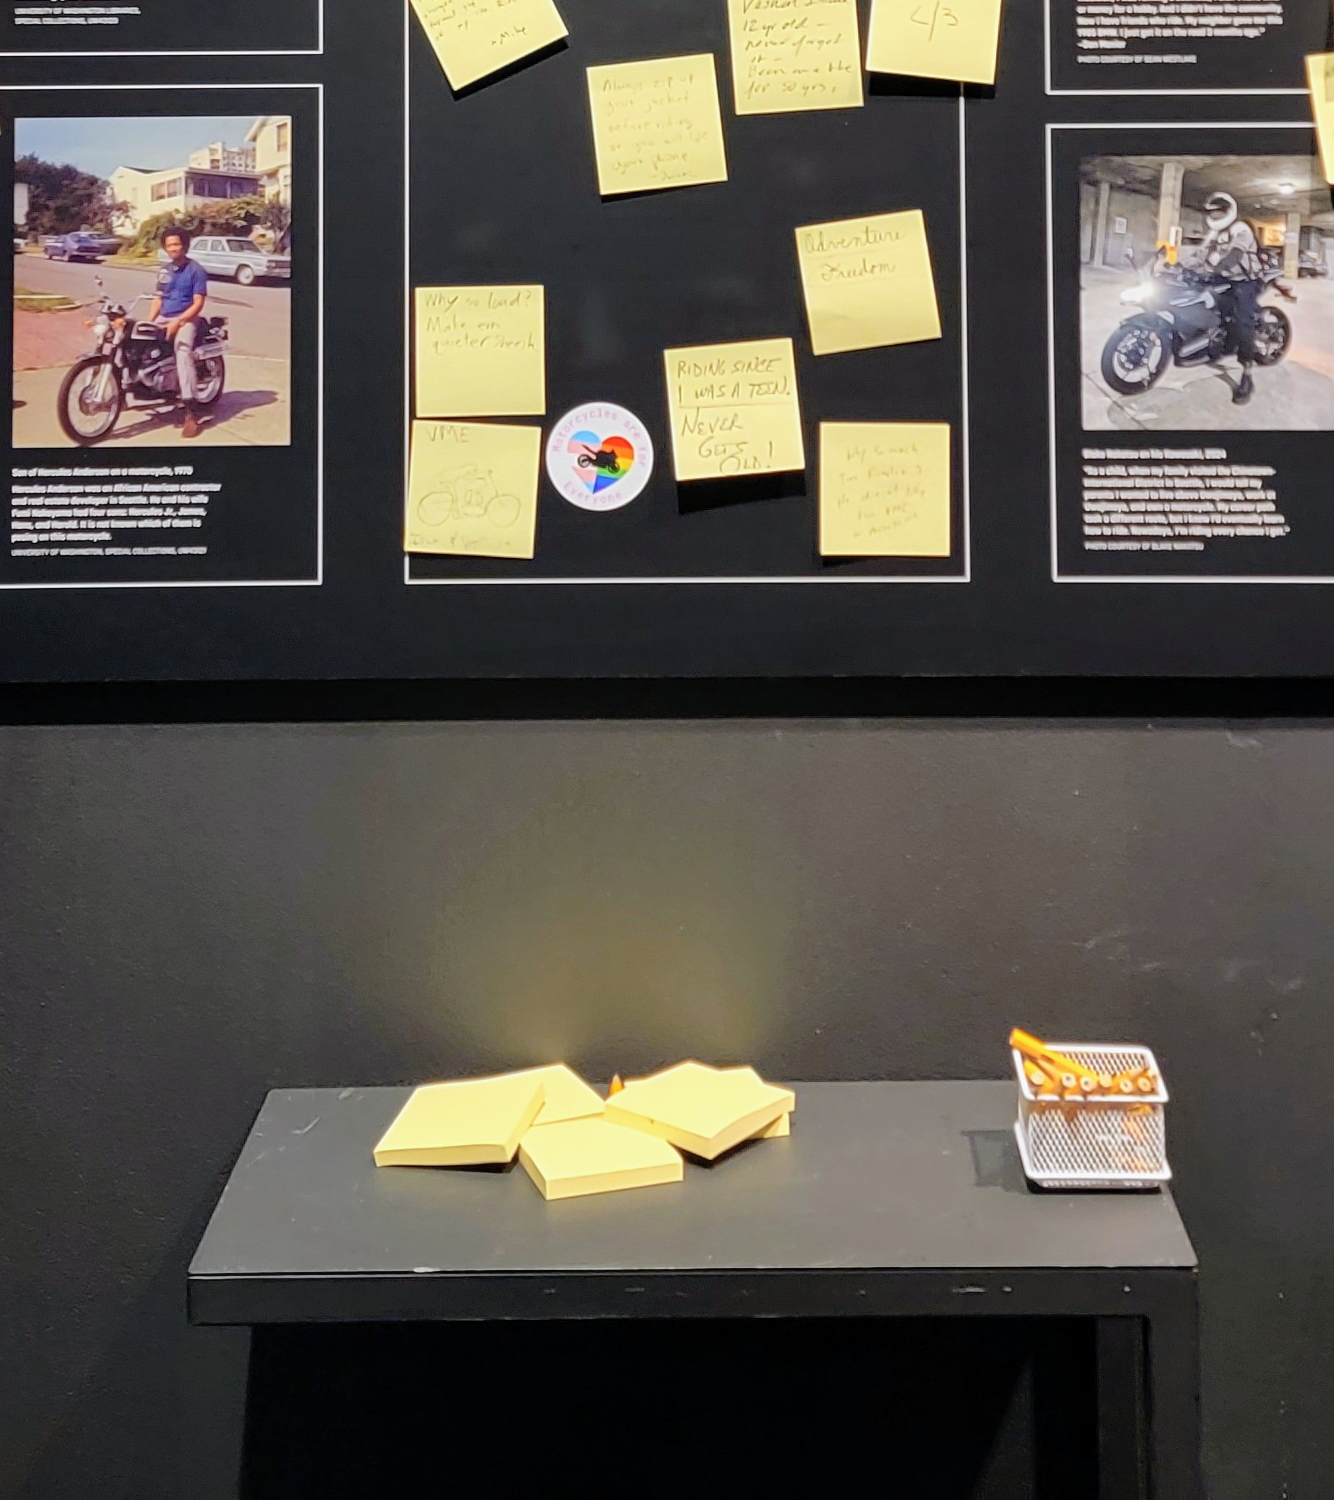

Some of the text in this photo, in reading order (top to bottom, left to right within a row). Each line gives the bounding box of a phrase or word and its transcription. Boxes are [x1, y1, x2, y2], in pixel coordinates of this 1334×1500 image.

[821, 258, 896, 281] Freedom
[426, 292, 459, 312] Why
[678, 356, 782, 378] RIDING SINCE
[695, 384, 727, 400] WAS
[731, 382, 740, 398] A
[552, 407, 618, 452] Motorcycles
[623, 420, 641, 437] are
[564, 480, 621, 504] Everyone
